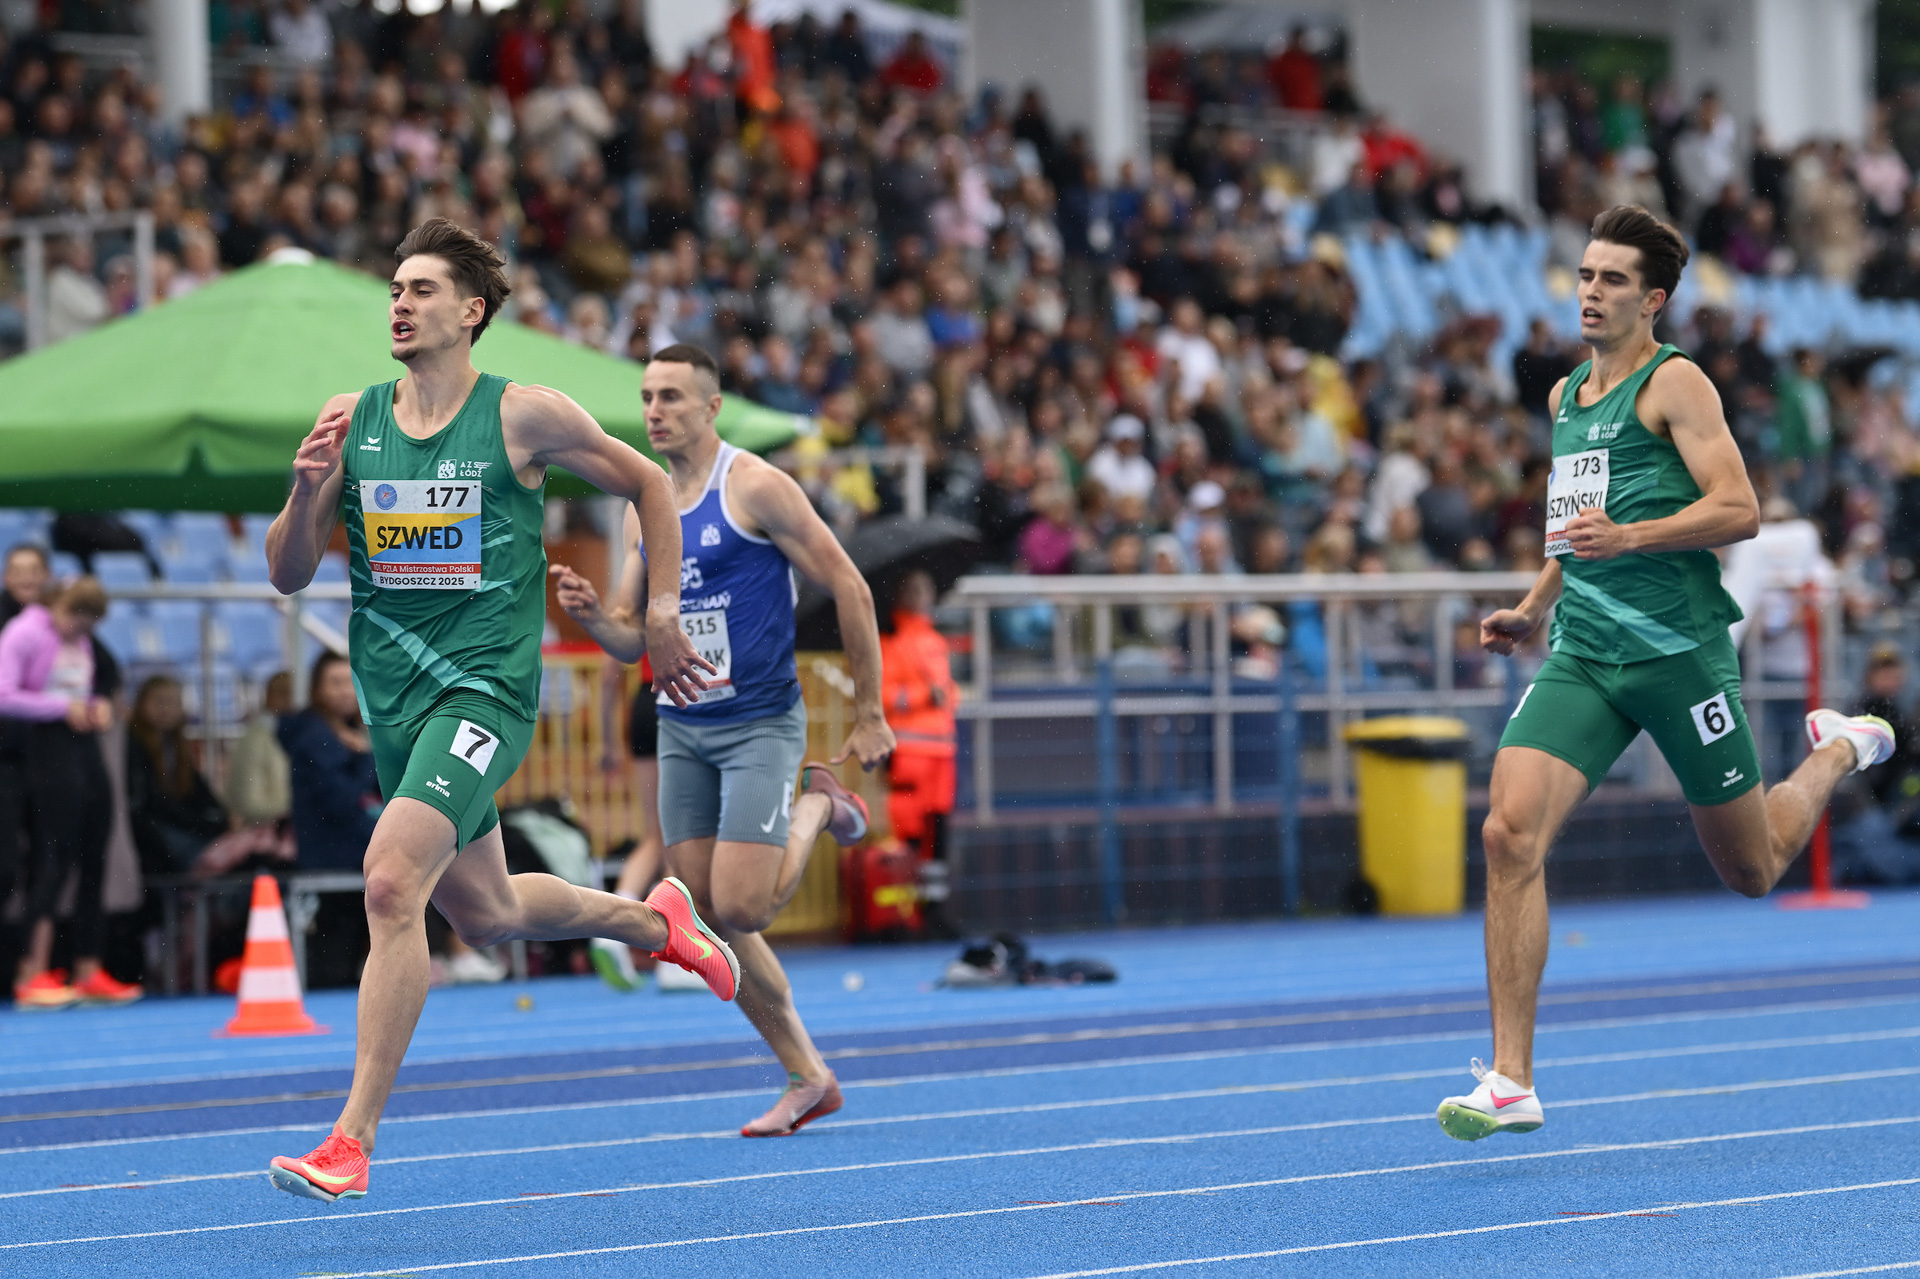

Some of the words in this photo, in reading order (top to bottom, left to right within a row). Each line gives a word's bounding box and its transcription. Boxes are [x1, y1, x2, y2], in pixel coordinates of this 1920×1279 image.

[1573, 456, 1600, 477] 173
[426, 487, 469, 507] 177
[377, 526, 463, 549] SZWED
[383, 564, 399, 572] PZLA
[400, 565, 448, 573] Mistrzostwa
[449, 565, 474, 573] Polski
[380, 576, 437, 586] BYDGOSZCZ
[438, 577, 465, 586] 2025
[686, 617, 717, 637] 515
[700, 648, 726, 668] AK
[1703, 702, 1726, 734] 6
[464, 726, 492, 760] 7
[425, 780, 451, 798] erima
